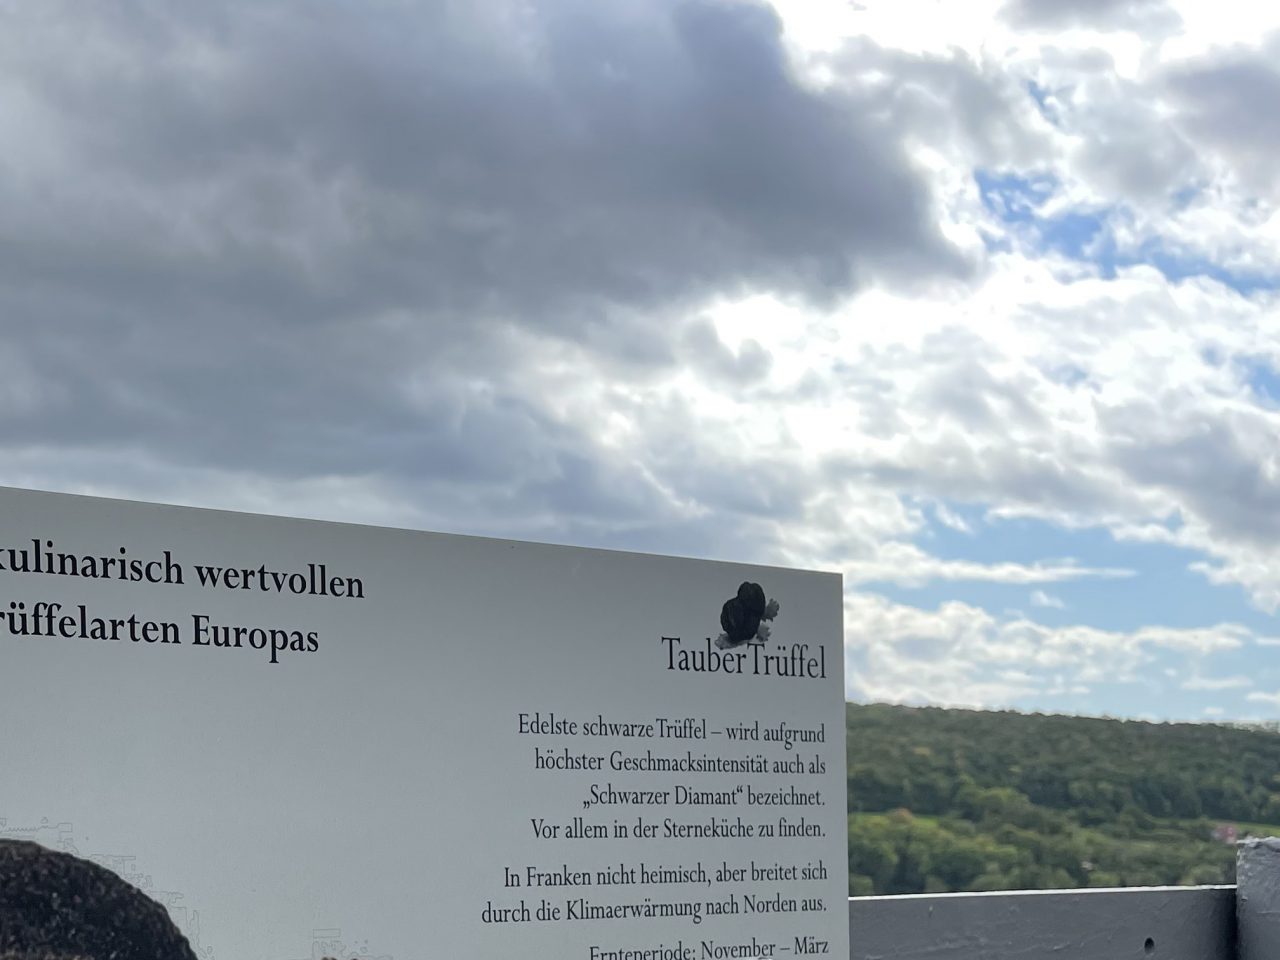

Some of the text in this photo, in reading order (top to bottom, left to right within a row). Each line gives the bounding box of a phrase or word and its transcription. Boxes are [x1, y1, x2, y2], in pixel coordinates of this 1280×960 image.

[193, 564, 365, 598] wertvollen
[191, 615, 318, 663] Europas
[518, 712, 577, 735] Edelste
[583, 715, 654, 737] schwarze
[656, 718, 706, 739] Trüffel
[726, 721, 759, 741] wird
[764, 722, 824, 750] aufgrund
[535, 747, 825, 774] höchster Geschmacksintensität auch als
[747, 785, 825, 805] bezeichnet.
[531, 817, 825, 839] Vor allem in der Sterneküche zu finden.
[505, 860, 827, 887] In Franken nicht heimisch, aber breitet sich
[482, 892, 826, 924] durch die Klimaerwärmung nach Norden aus.
[701, 937, 776, 960] November
[794, 936, 829, 955] März
